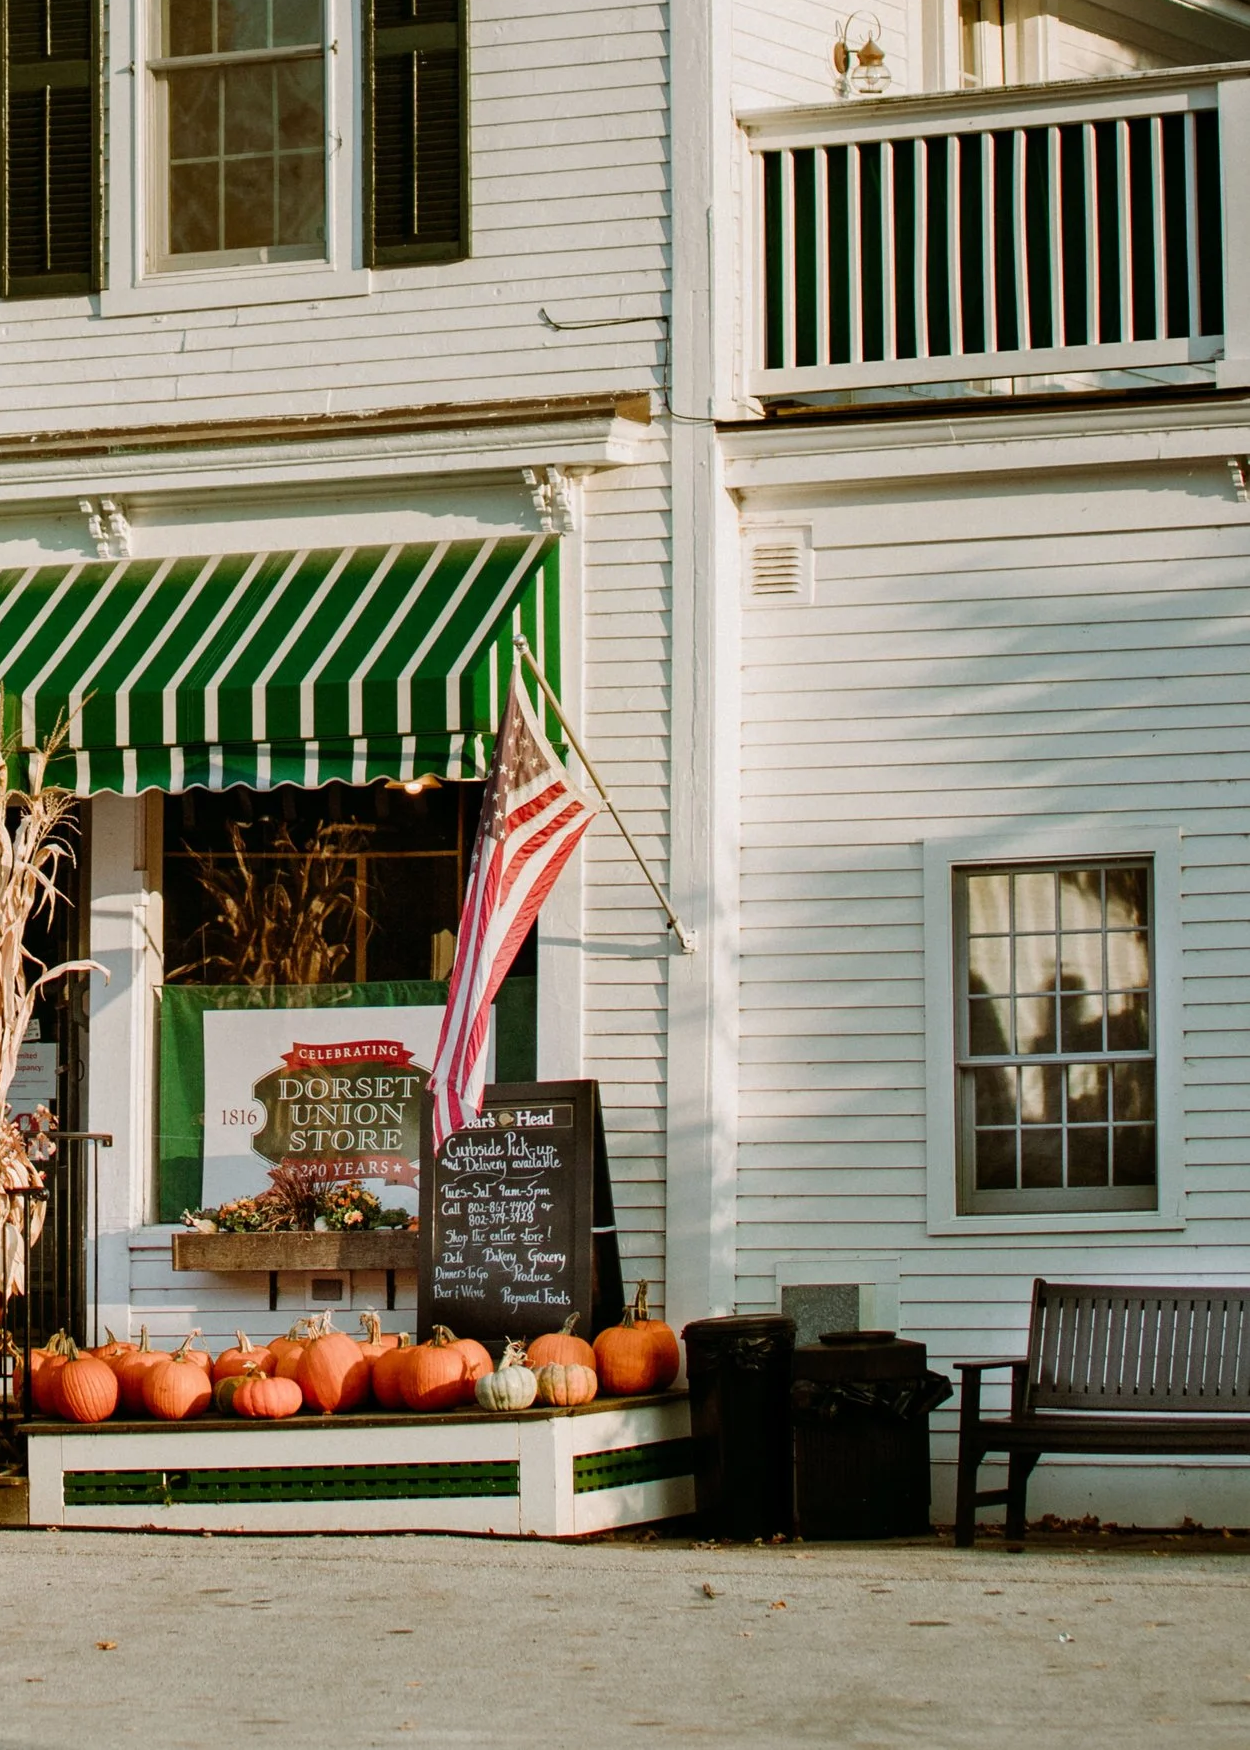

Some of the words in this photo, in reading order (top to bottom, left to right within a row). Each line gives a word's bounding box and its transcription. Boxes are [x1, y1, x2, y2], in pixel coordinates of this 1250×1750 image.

[298, 1045, 399, 1060] CELEBRATING
[277, 1076, 420, 1100] DORSET
[221, 1109, 258, 1126] 1816
[290, 1102, 406, 1126] UNION
[460, 1112, 496, 1130] oar's
[515, 1109, 554, 1127] Head
[288, 1128, 403, 1151] STORE
[446, 1138, 505, 1158] Curbside
[333, 1160, 389, 1176] YEARS
[441, 1159, 461, 1171] and
[465, 1157, 507, 1174] Delivery
[512, 1154, 562, 1169] available
[440, 1181, 496, 1199] Tues-Sat
[499, 1181, 551, 1201] 9am-5pm
[441, 1201, 462, 1215] Call
[467, 1201, 536, 1214] 802-867-4400
[541, 1202, 554, 1212] or
[468, 1212, 534, 1226] 802-379-3928
[444, 1230, 468, 1248] Shop
[472, 1227, 488, 1242] the
[490, 1226, 517, 1242] entire
[442, 1252, 464, 1264] Deli
[482, 1248, 517, 1266] Bakery
[528, 1248, 566, 1272] Grocery
[435, 1266, 466, 1281] Dinners
[476, 1267, 489, 1284] Go
[512, 1264, 553, 1282] Produce
[501, 1286, 541, 1313] Prepared
[542, 1288, 571, 1305] Foods
